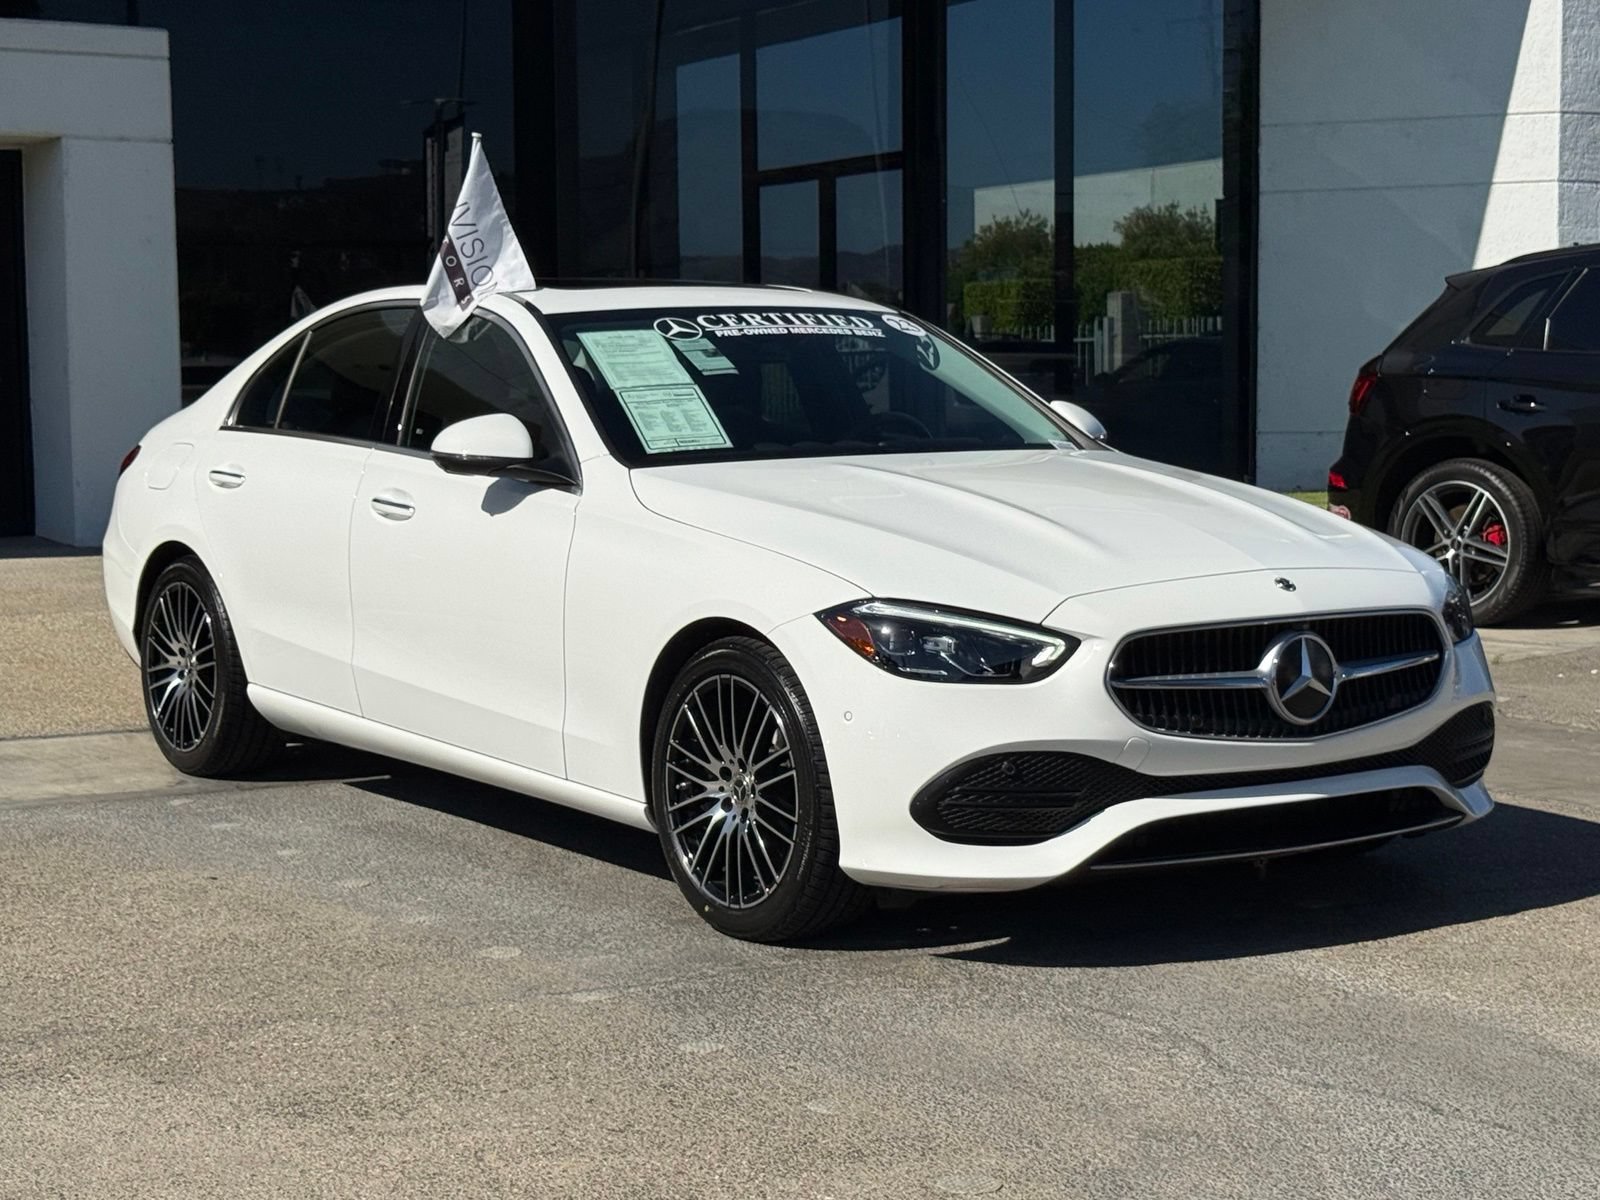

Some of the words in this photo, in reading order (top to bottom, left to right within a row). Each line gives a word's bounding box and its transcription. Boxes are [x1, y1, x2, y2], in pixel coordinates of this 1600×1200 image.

[696, 312, 874, 329] CERTIFIED
[715, 328, 788, 337] PRE-OWNED
[790, 328, 852, 336] MERCEDES
[852, 328, 886, 338] BENZ
